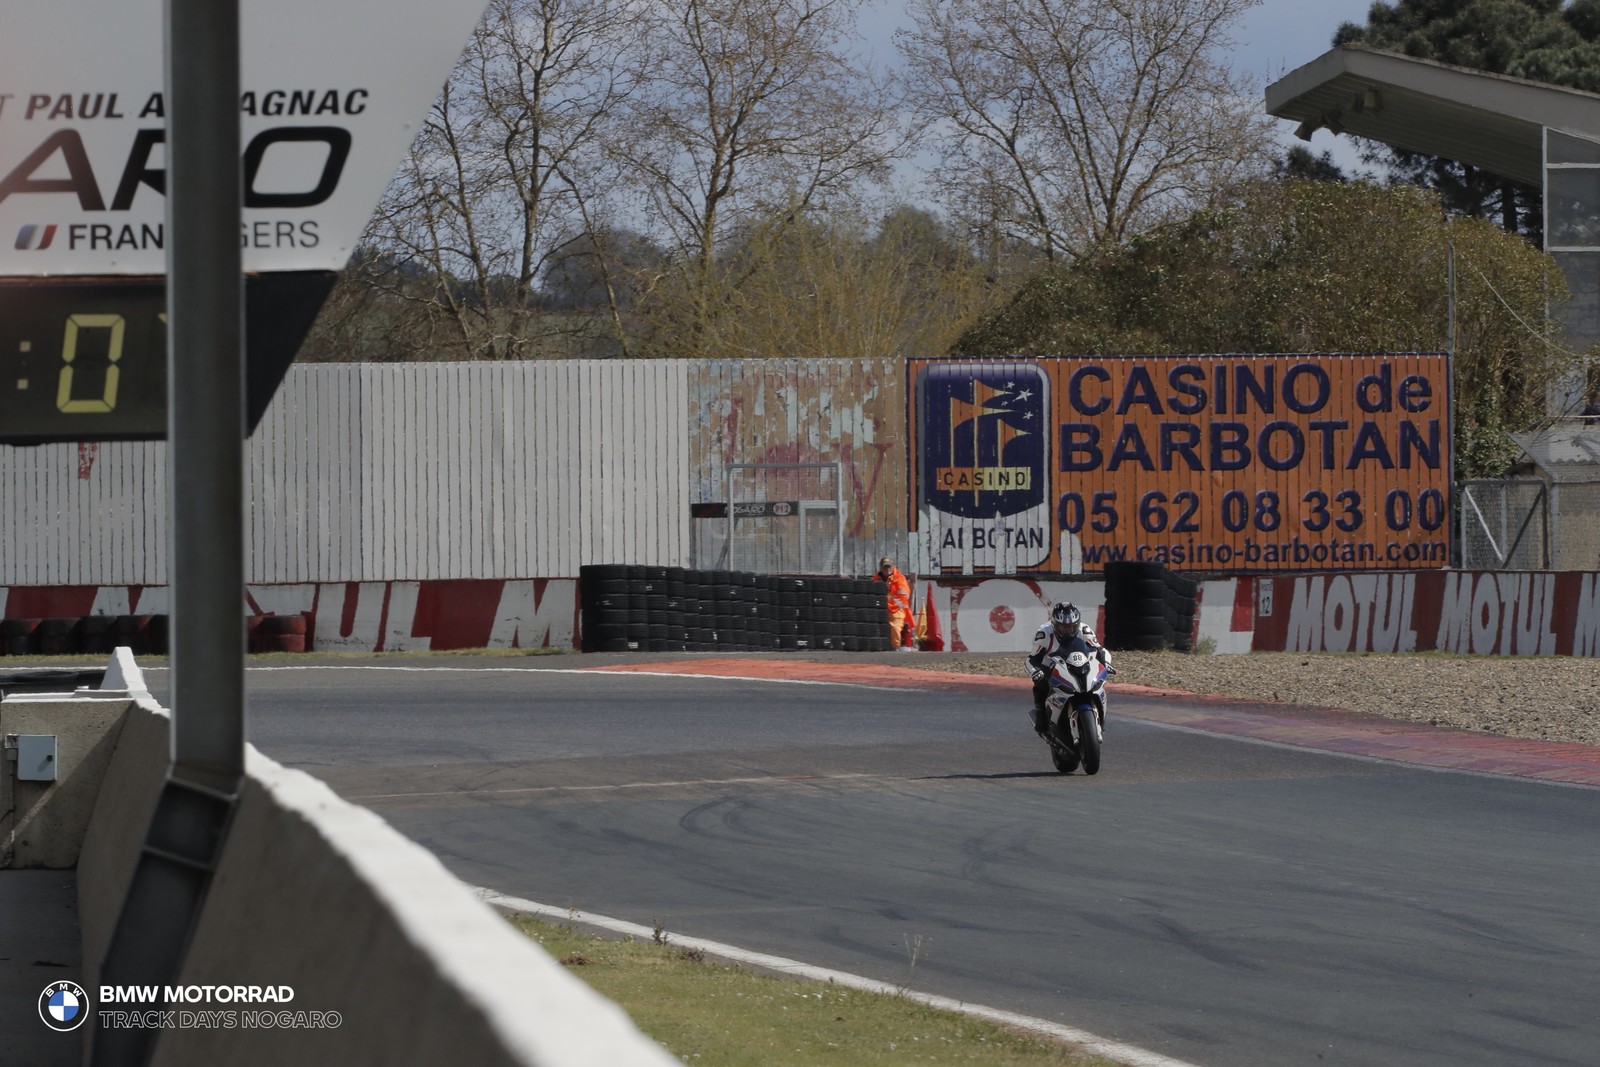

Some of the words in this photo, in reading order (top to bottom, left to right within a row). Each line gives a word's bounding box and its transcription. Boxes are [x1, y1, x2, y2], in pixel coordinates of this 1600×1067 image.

[24, 93, 123, 120] PAUL
[68, 223, 164, 250] FRAN
[240, 220, 319, 249] ERS
[1069, 363, 1331, 416] CASINO
[1355, 362, 1433, 413] de
[1060, 419, 1441, 472] BARBOTAN
[943, 471, 1026, 487] CASINO
[1058, 490, 1119, 534] 05
[1139, 490, 1200, 533] 62
[1221, 490, 1282, 533] 08
[1302, 489, 1364, 533] 33
[1384, 488, 1445, 532] 00
[1057, 536, 1446, 564] ww.casino-barbotan.com
[1285, 573, 1418, 653] MOTUL
[1435, 571, 1557, 656] MOTUL
